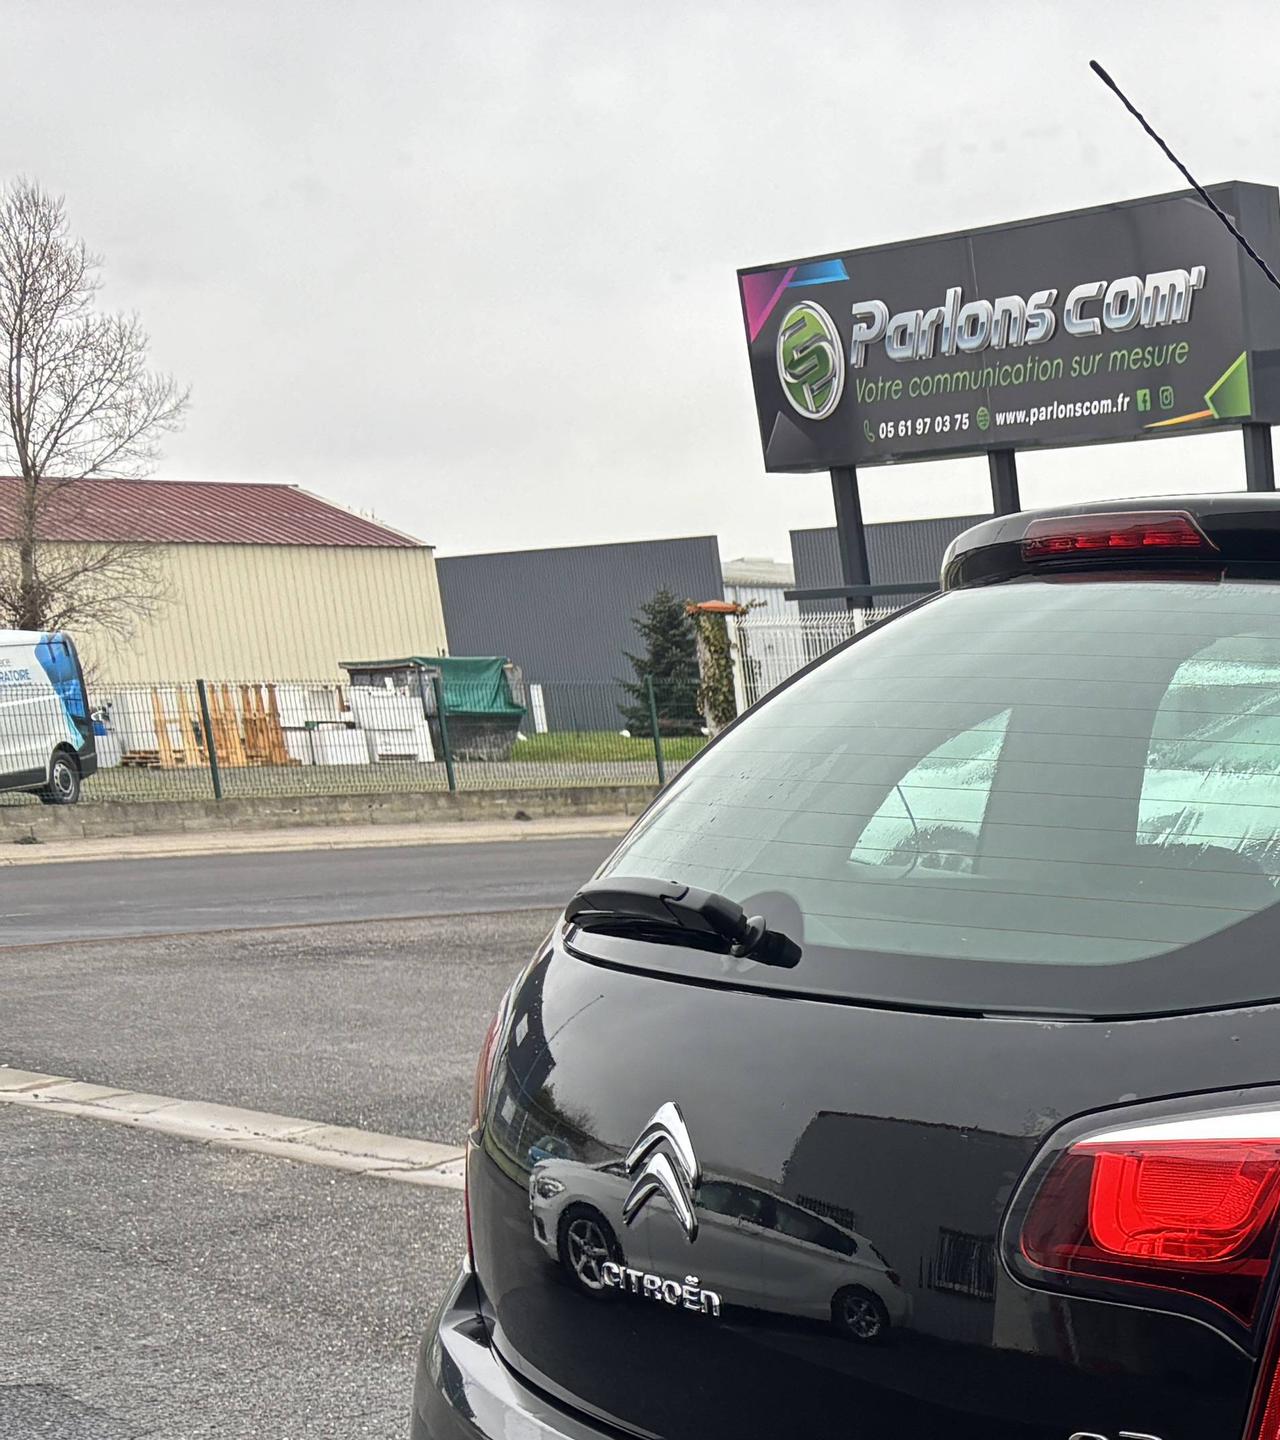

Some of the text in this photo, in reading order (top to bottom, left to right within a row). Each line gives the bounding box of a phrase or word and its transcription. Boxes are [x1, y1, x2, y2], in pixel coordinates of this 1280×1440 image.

[851, 286, 1058, 369] Parlons
[856, 341, 1189, 403] Votre communication sur mesure
[879, 393, 1130, 439] 05 61 97 03 75 www.parlonscom.fr
